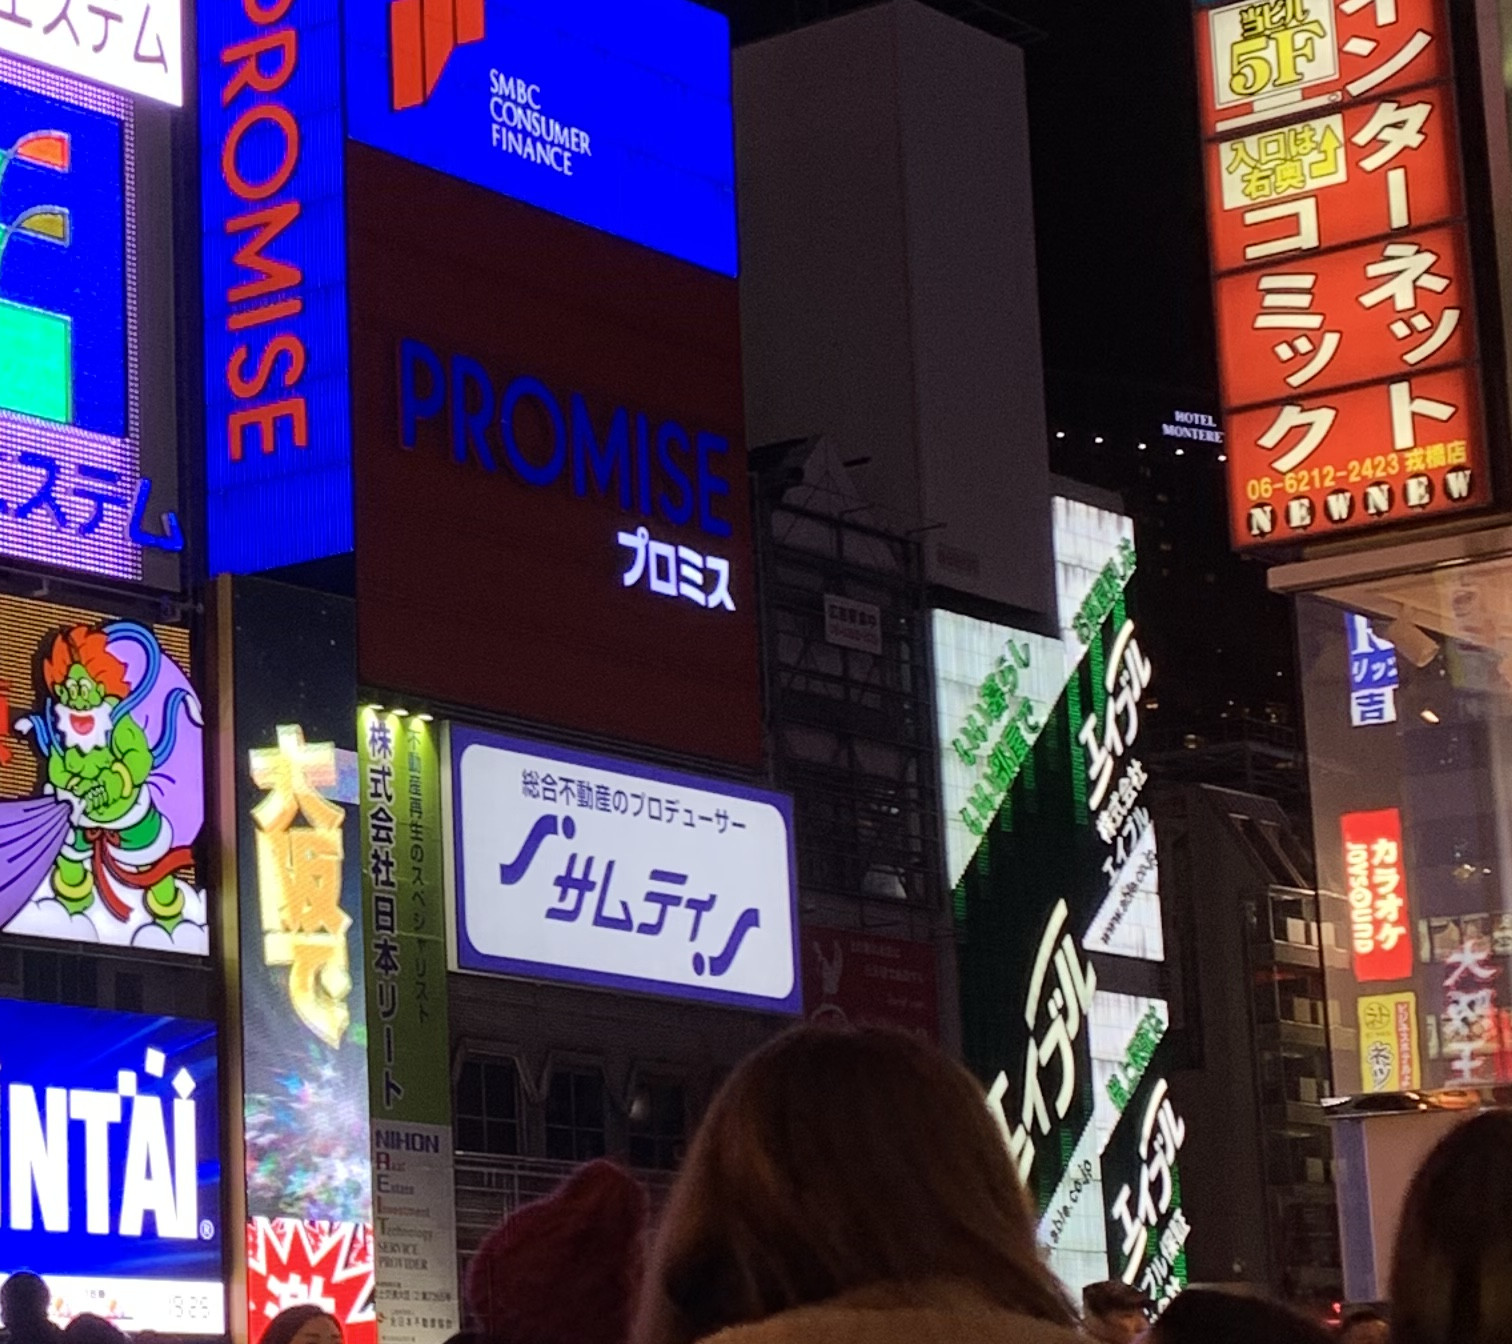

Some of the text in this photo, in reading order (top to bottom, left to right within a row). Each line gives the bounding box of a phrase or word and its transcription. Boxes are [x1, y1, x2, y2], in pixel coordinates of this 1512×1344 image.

[489, 68, 541, 110] SMBC
[1229, 20, 1327, 96] 5F
[489, 96, 592, 156] CONSUMER
[491, 123, 573, 176] FINANCE
[1226, 124, 1319, 174] 入口は
[1242, 196, 1341, 474] コミック
[400, 336, 733, 537] PROMISE
[1162, 423, 1225, 444] MONTERE
[1174, 410, 1217, 427] HOTEL
[1246, 454, 1400, 501] 06-6212-2423
[617, 526, 736, 612] プロミス
[1078, 631, 1152, 791] エイブル
[521, 768, 747, 834] 総合不動産のプロデューサー
[545, 853, 718, 943] サムティ
[1371, 837, 1407, 951] カラオケ
[375, 1130, 440, 1154] NIHON
[1113, 1091, 1186, 1261] エイブル
